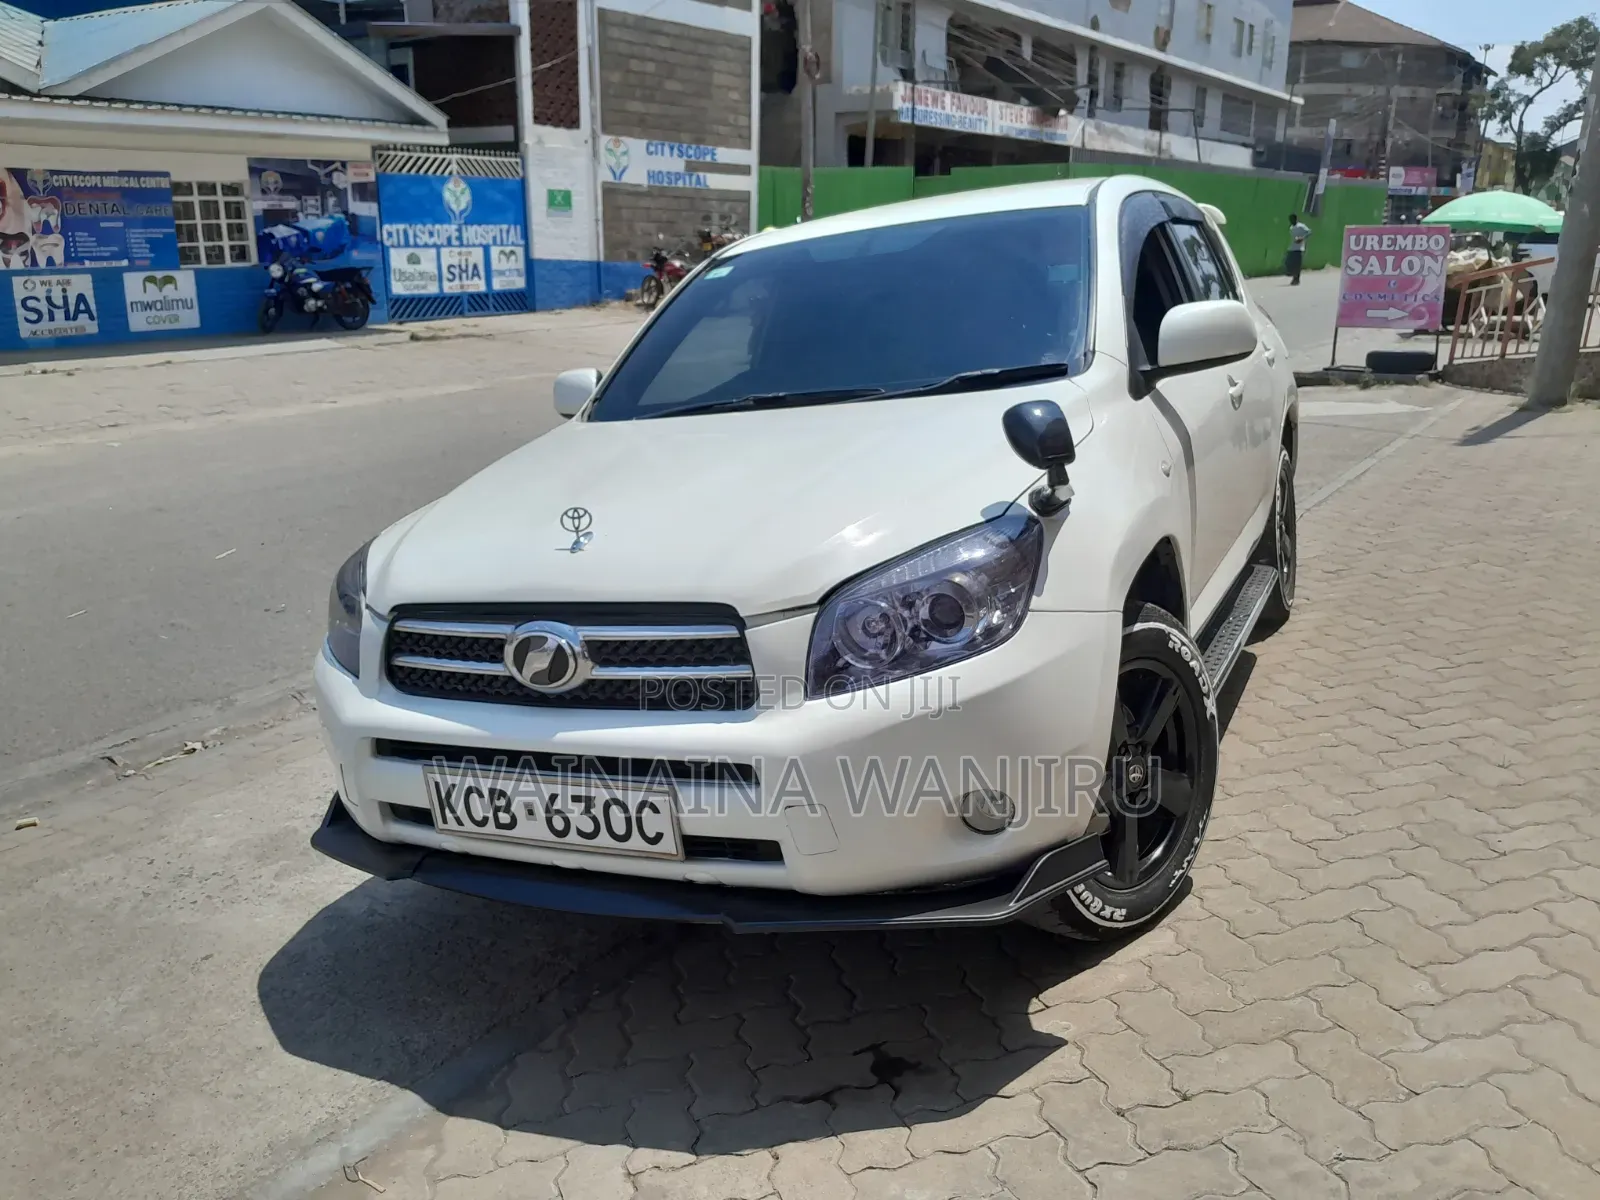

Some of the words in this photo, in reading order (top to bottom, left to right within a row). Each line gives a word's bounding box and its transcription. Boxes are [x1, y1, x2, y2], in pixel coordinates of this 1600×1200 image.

[646, 142, 718, 162] CITYSCOPE
[52, 175, 101, 188] CITYSCOPE
[646, 170, 710, 188] HOSPITAL
[64, 202, 130, 217] DENTAL
[382, 223, 460, 246] CITYSCOPE
[464, 224, 525, 246] HOSPITAL
[1349, 234, 1446, 251] UREMBO
[446, 259, 482, 283] SHA
[1346, 255, 1444, 276] SALON
[39, 280, 53, 288] WE
[56, 278, 73, 287] ARE
[20, 289, 96, 324] SHA
[130, 296, 194, 314] mwalimu
[1342, 293, 1441, 302] COSMETICS
[146, 314, 180, 325] COVER
[433, 781, 518, 831] KCB
[545, 792, 665, 846] 630C
